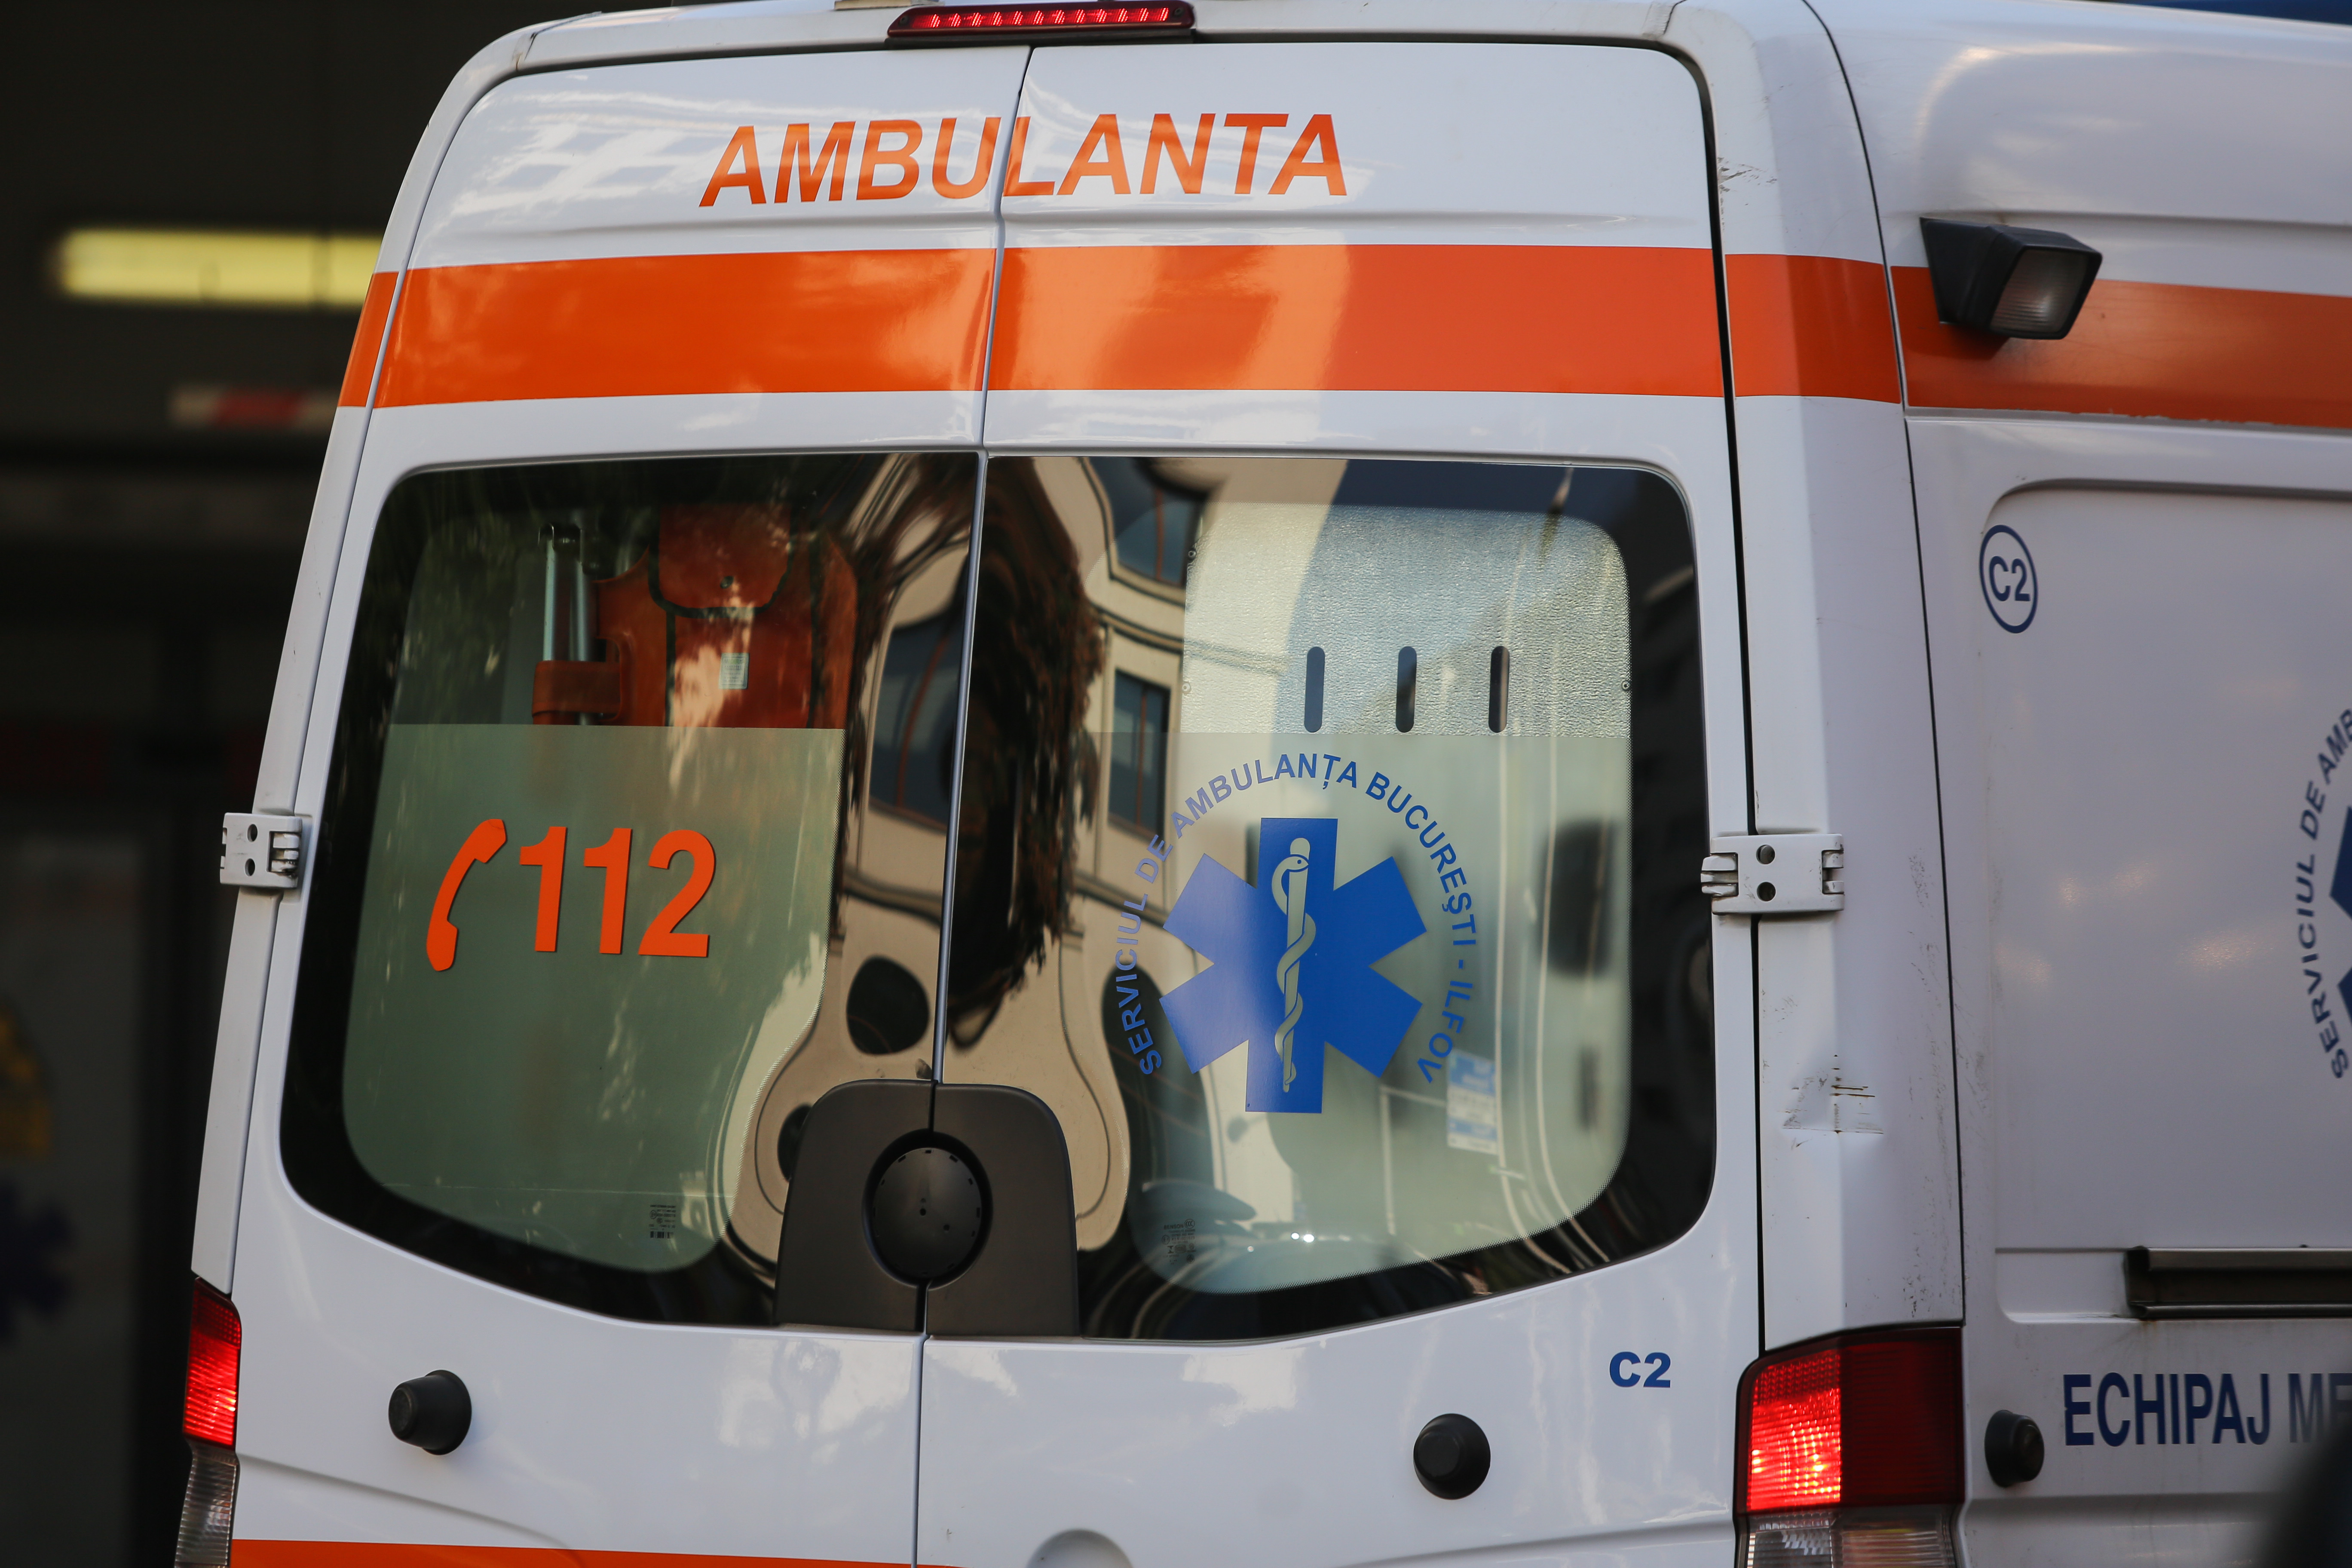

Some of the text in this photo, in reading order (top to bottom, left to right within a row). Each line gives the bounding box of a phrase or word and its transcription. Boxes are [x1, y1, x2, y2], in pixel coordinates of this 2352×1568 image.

[699, 113, 1347, 207] AMBULANTA
[1989, 555, 2031, 602] C2
[1170, 753, 1357, 839] AMBULANȚA
[2300, 781, 2327, 841] DE
[519, 827, 717, 957] 112
[1134, 835, 1173, 883] DE
[1366, 772, 1476, 945] BUCUREȘTI
[1115, 893, 1162, 1075] SERVICIUL
[2296, 854, 2349, 1078] SERVICIUL
[1416, 980, 1473, 1083] ILFOV
[1609, 1351, 1671, 1388] C2
[2063, 1372, 2270, 1446] ECHIPAJ
